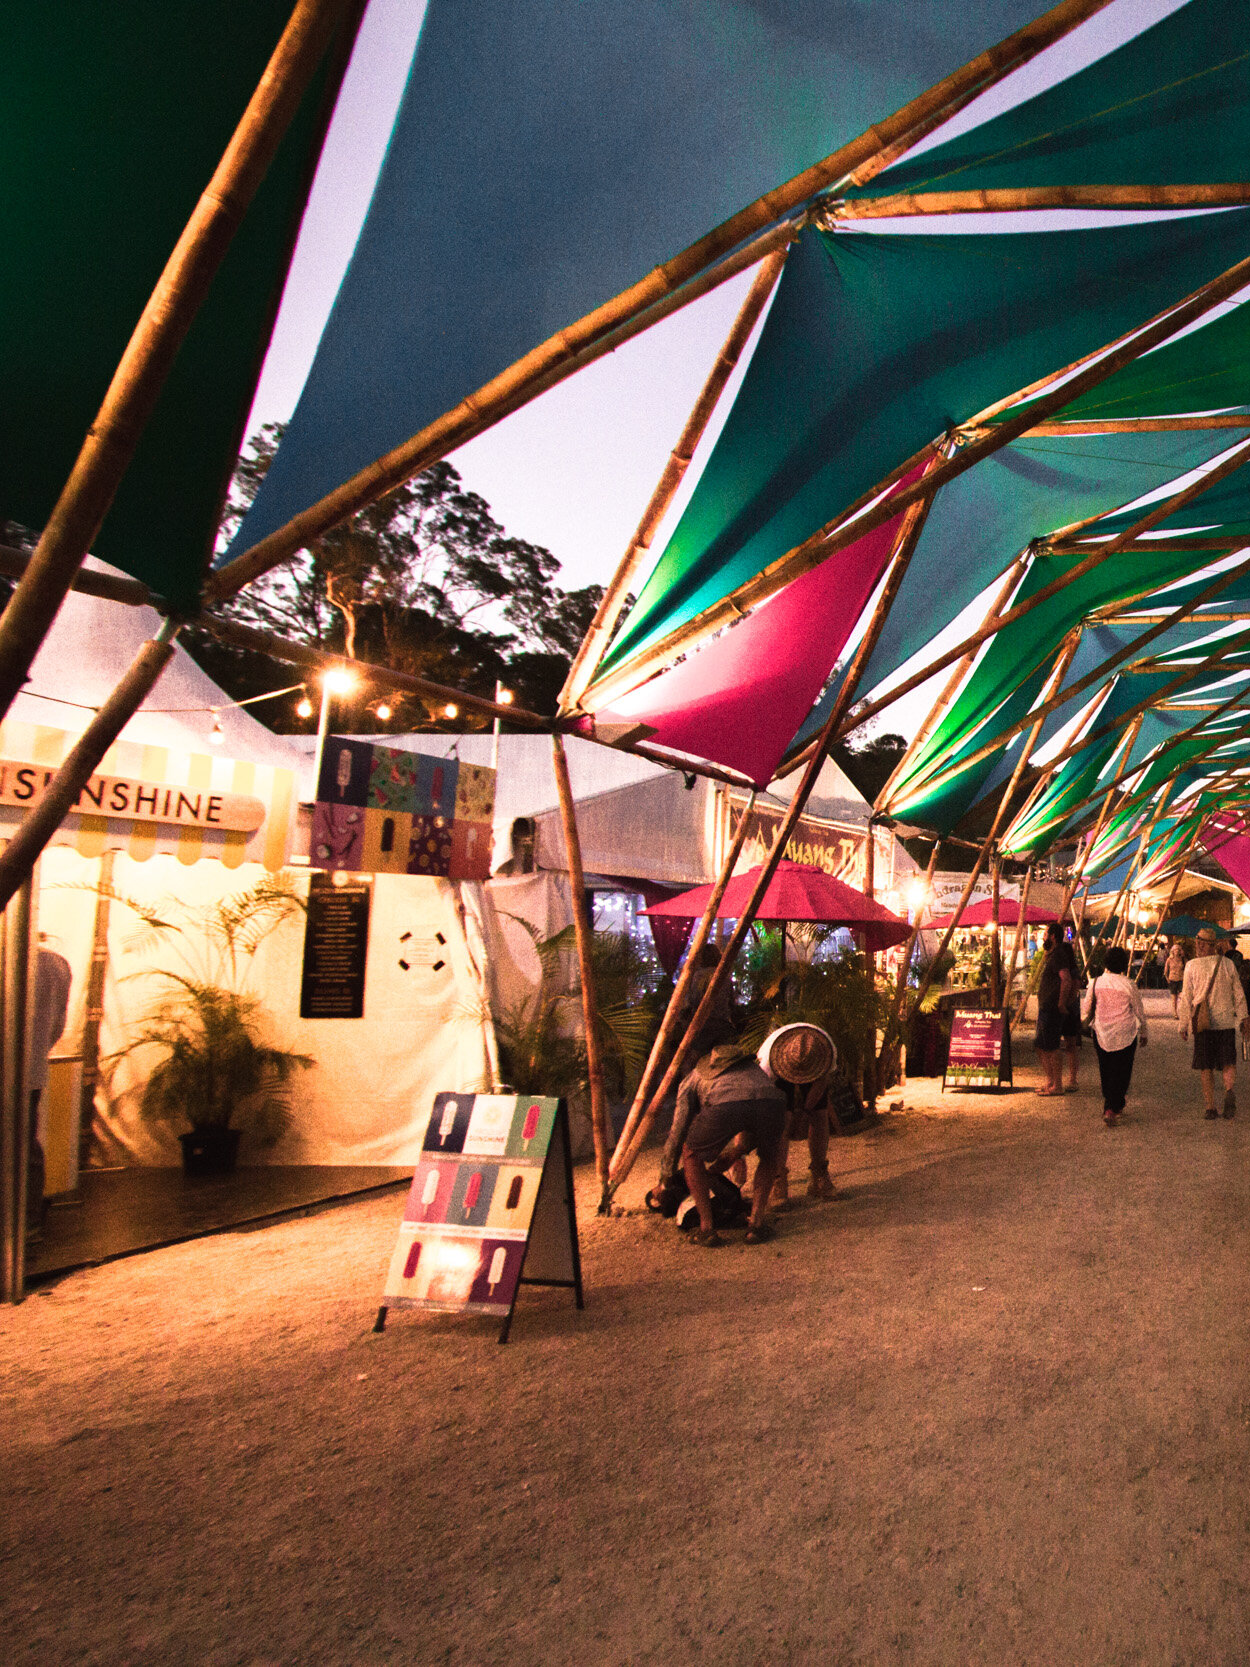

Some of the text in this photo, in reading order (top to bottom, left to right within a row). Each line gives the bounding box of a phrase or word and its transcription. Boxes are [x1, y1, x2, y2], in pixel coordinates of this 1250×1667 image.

[14, 769, 223, 823] SNSHINE
[955, 1010, 1001, 1020] Muang Thai
